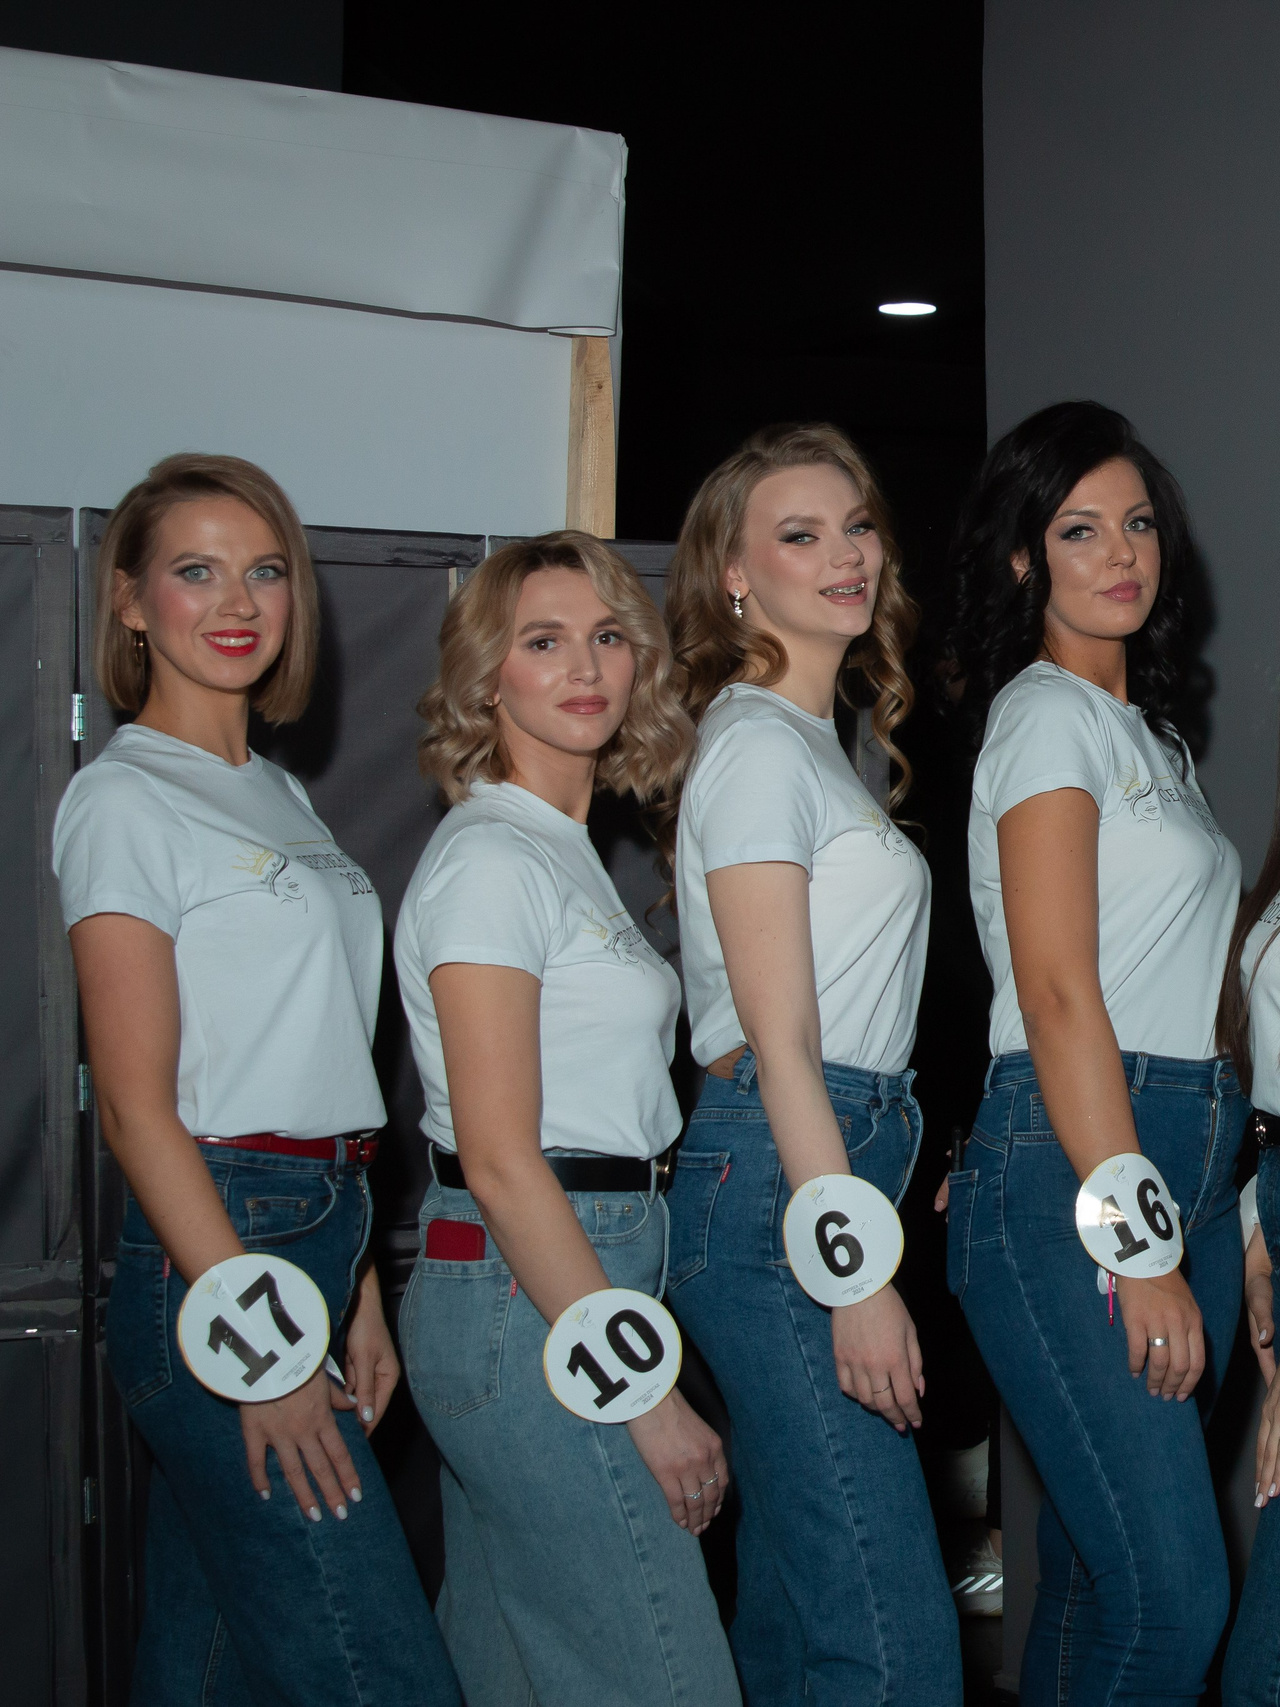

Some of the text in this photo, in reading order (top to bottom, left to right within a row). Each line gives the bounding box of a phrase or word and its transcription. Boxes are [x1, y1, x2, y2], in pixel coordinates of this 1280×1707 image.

[815, 1210, 865, 1278] 6
[1099, 1178, 1175, 1263] 16
[208, 1270, 305, 1387] 17
[567, 1308, 665, 1410] 10
